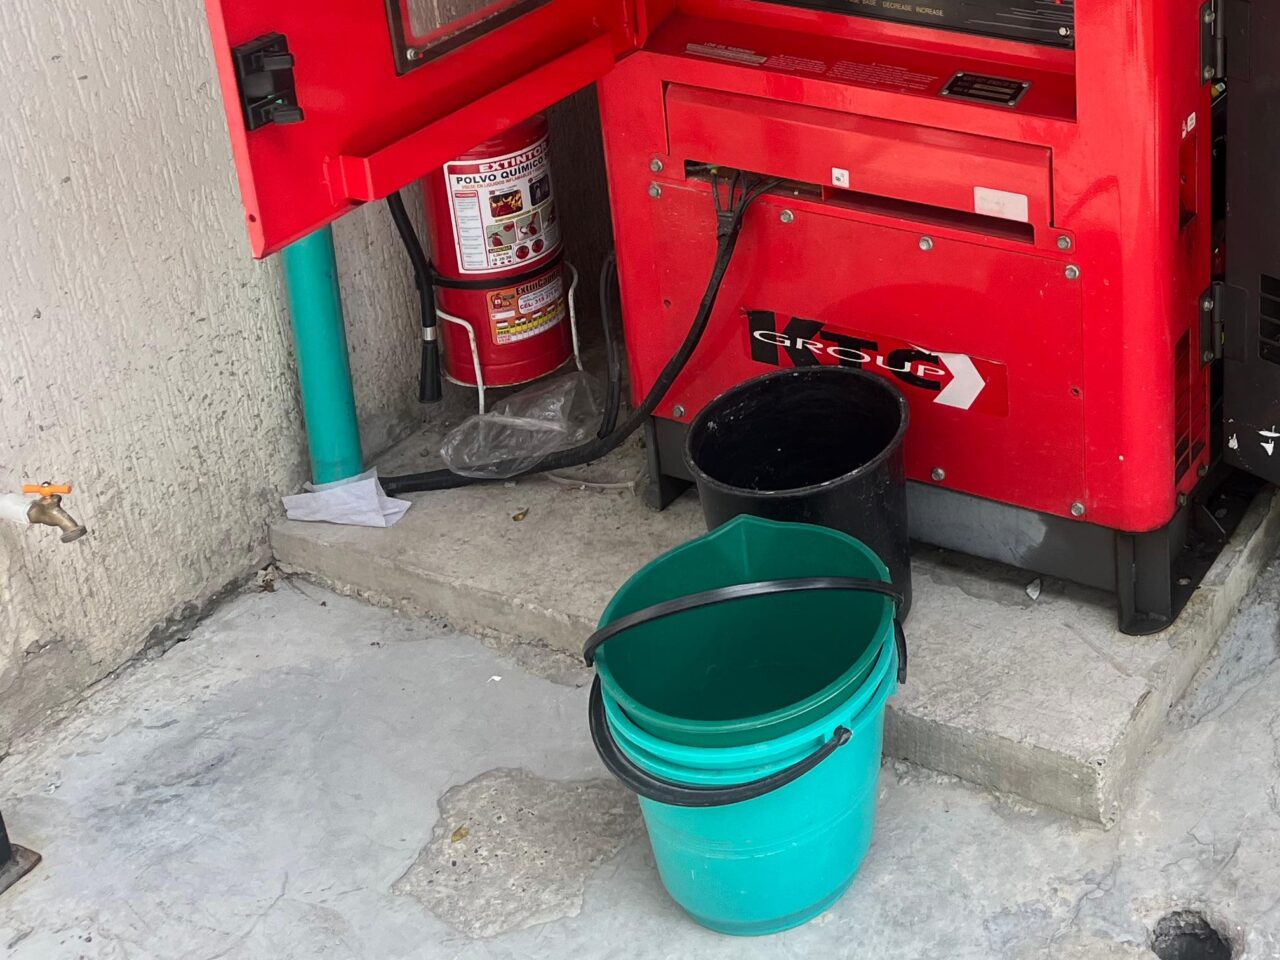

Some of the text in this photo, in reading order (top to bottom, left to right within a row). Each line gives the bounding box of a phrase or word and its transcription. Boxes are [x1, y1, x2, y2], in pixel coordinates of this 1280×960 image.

[882, 2, 912, 12] DECREASE
[915, 6, 944, 17] INCREASE
[456, 174, 497, 185] POLVO
[501, 157, 544, 178] QUÍMICO
[479, 141, 548, 172] EXTINTOR
[748, 310, 941, 390] KTC
[753, 330, 946, 377] GROUP
